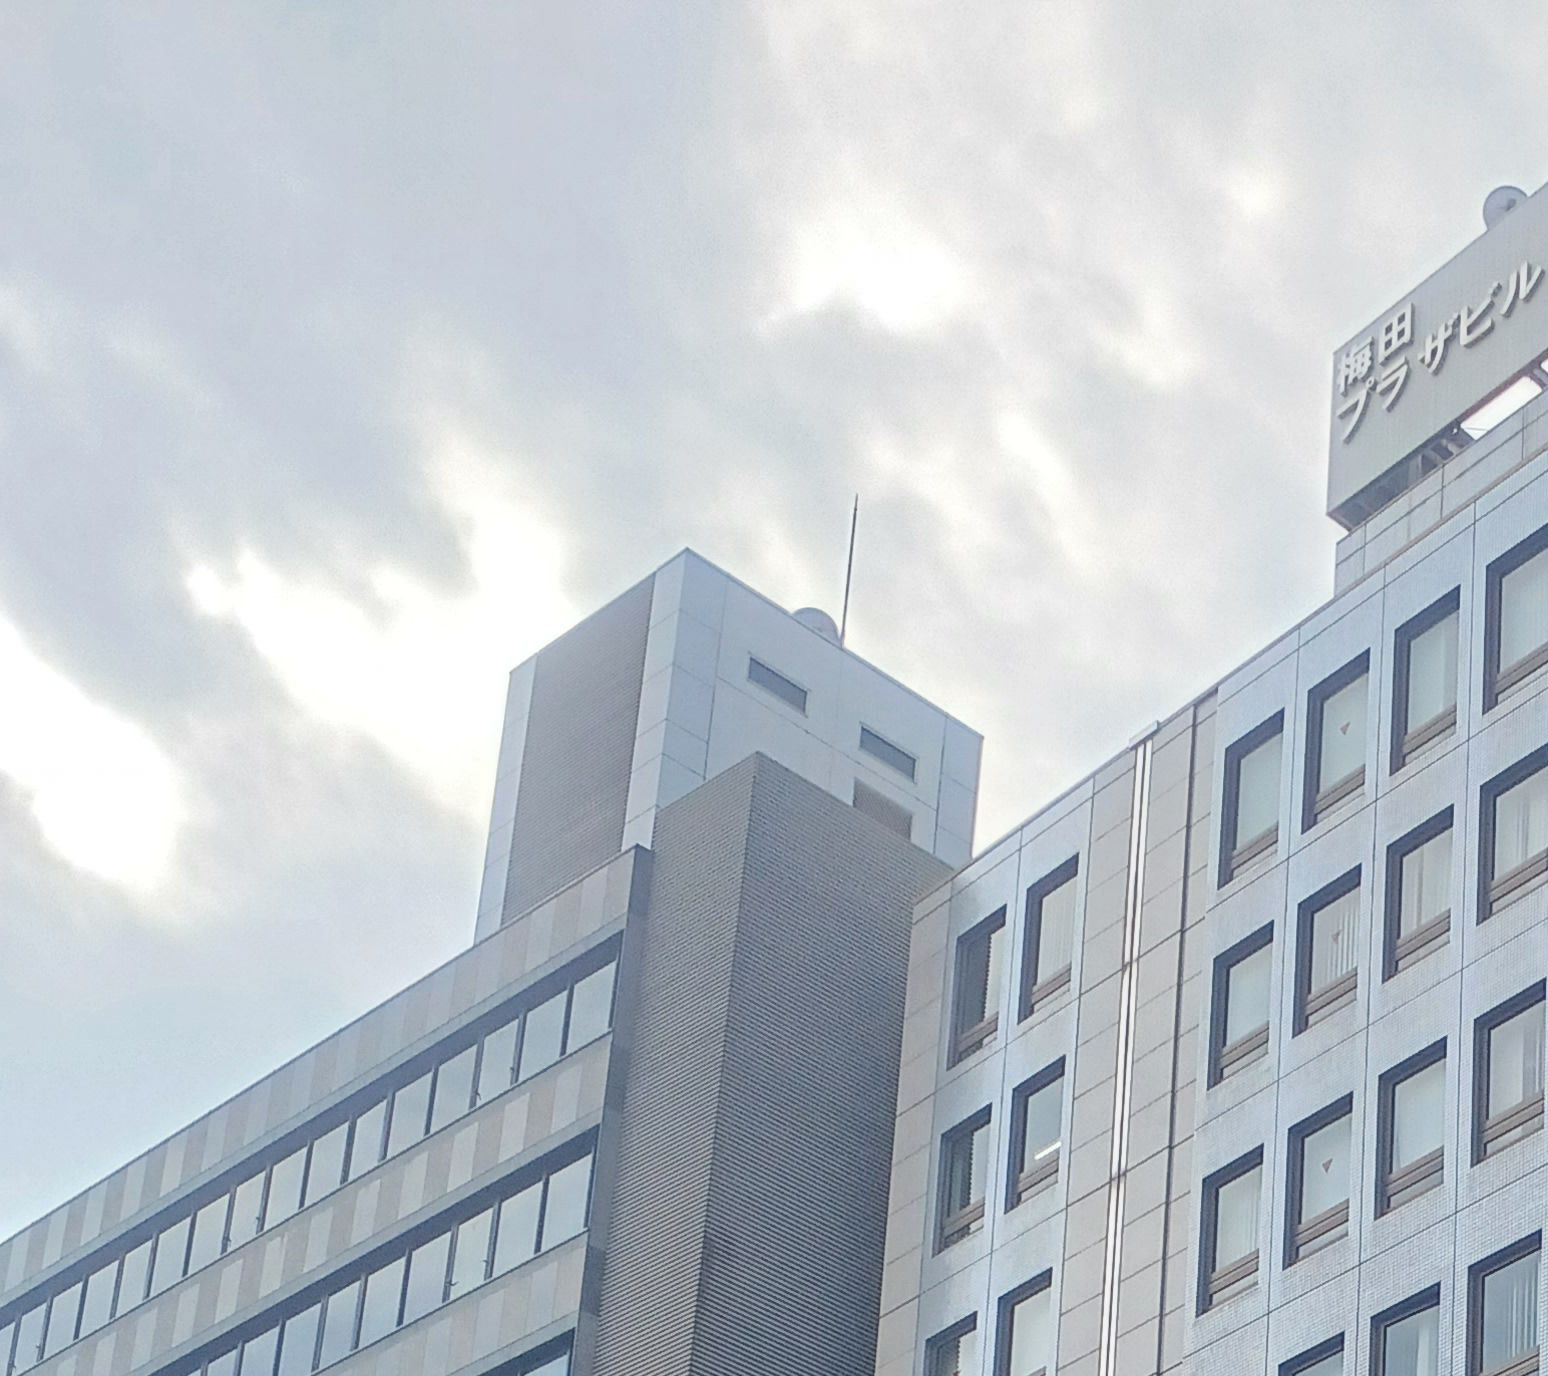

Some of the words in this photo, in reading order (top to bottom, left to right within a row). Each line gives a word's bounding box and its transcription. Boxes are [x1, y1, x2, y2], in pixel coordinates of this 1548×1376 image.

[1337, 261, 1545, 444] プラザビル
[1338, 302, 1415, 396] 梅田
